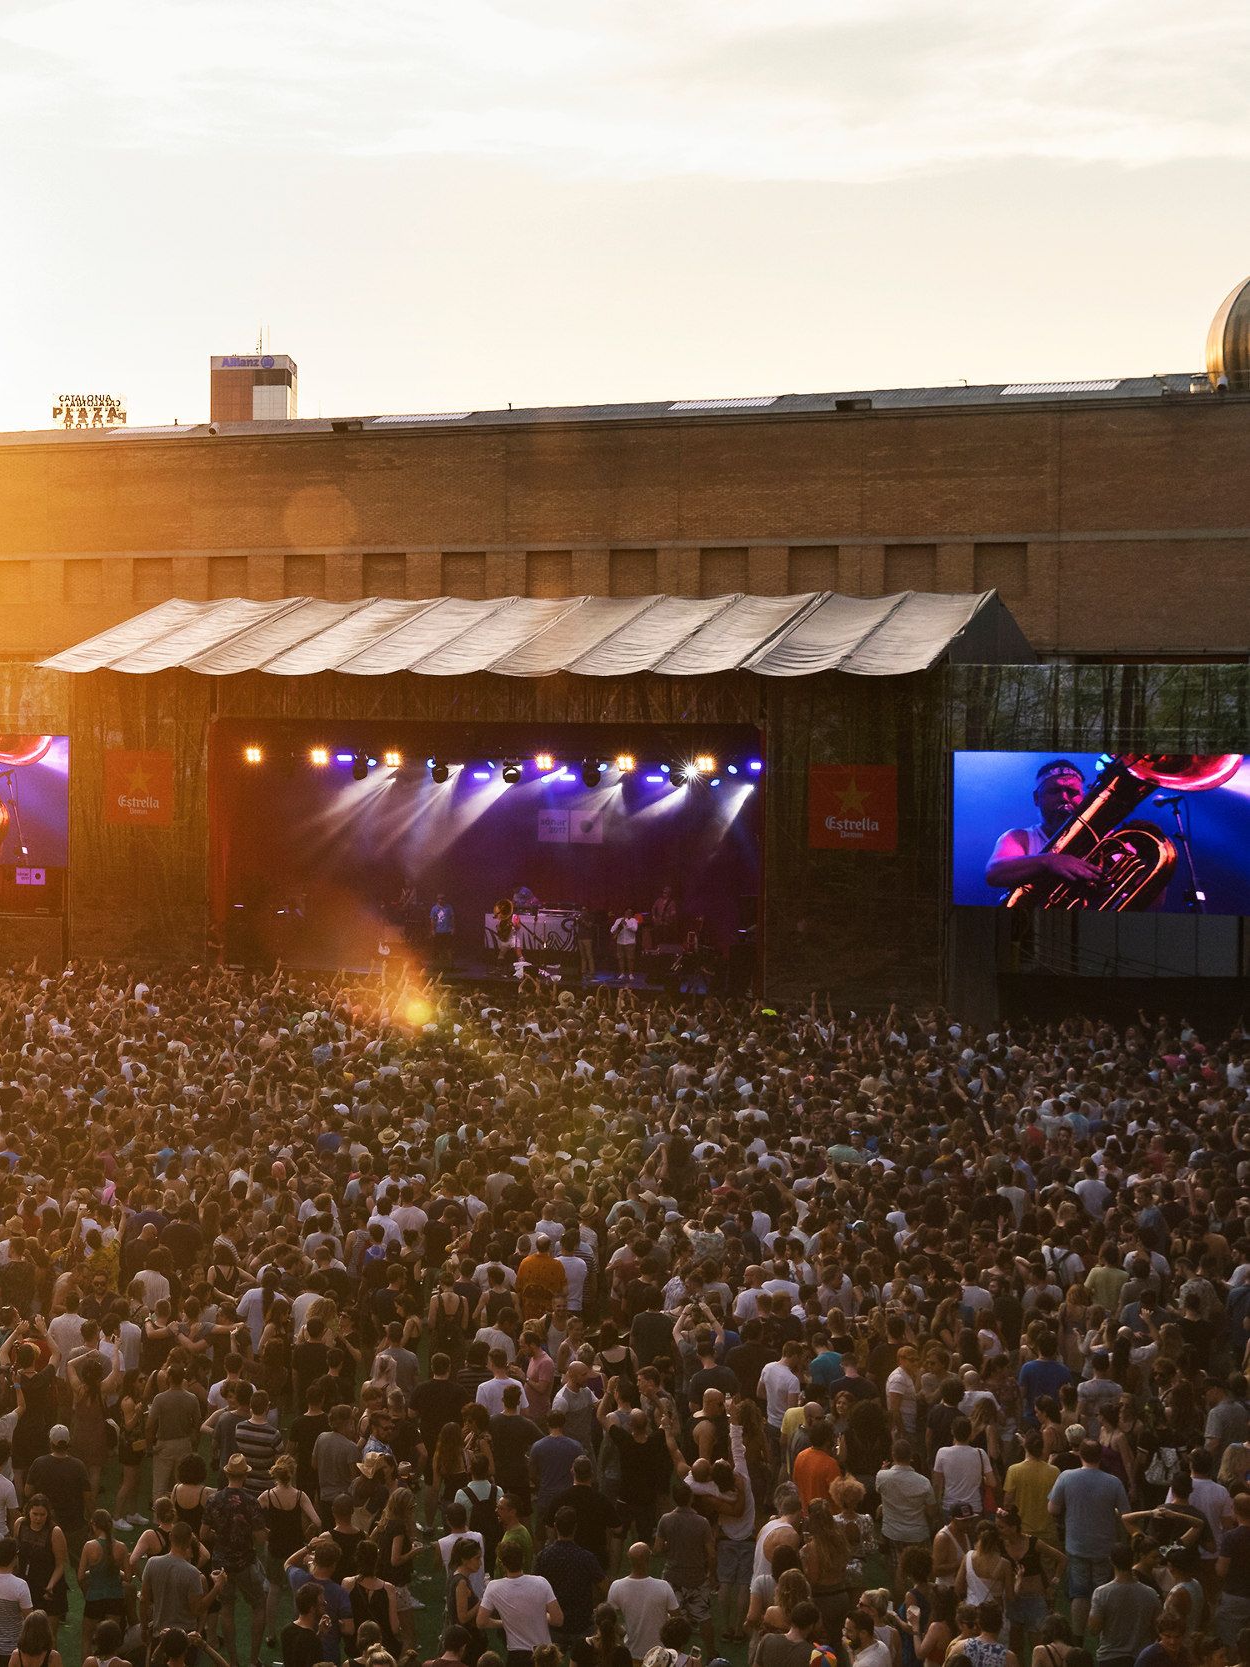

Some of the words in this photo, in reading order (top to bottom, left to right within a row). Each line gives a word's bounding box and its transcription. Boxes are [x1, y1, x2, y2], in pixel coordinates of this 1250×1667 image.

[222, 357, 260, 368] Allianz
[58, 394, 112, 402] CATALONIA
[52, 407, 117, 418] PLAZA
[117, 793, 160, 809] Estrella
[824, 815, 880, 832] Estrella
